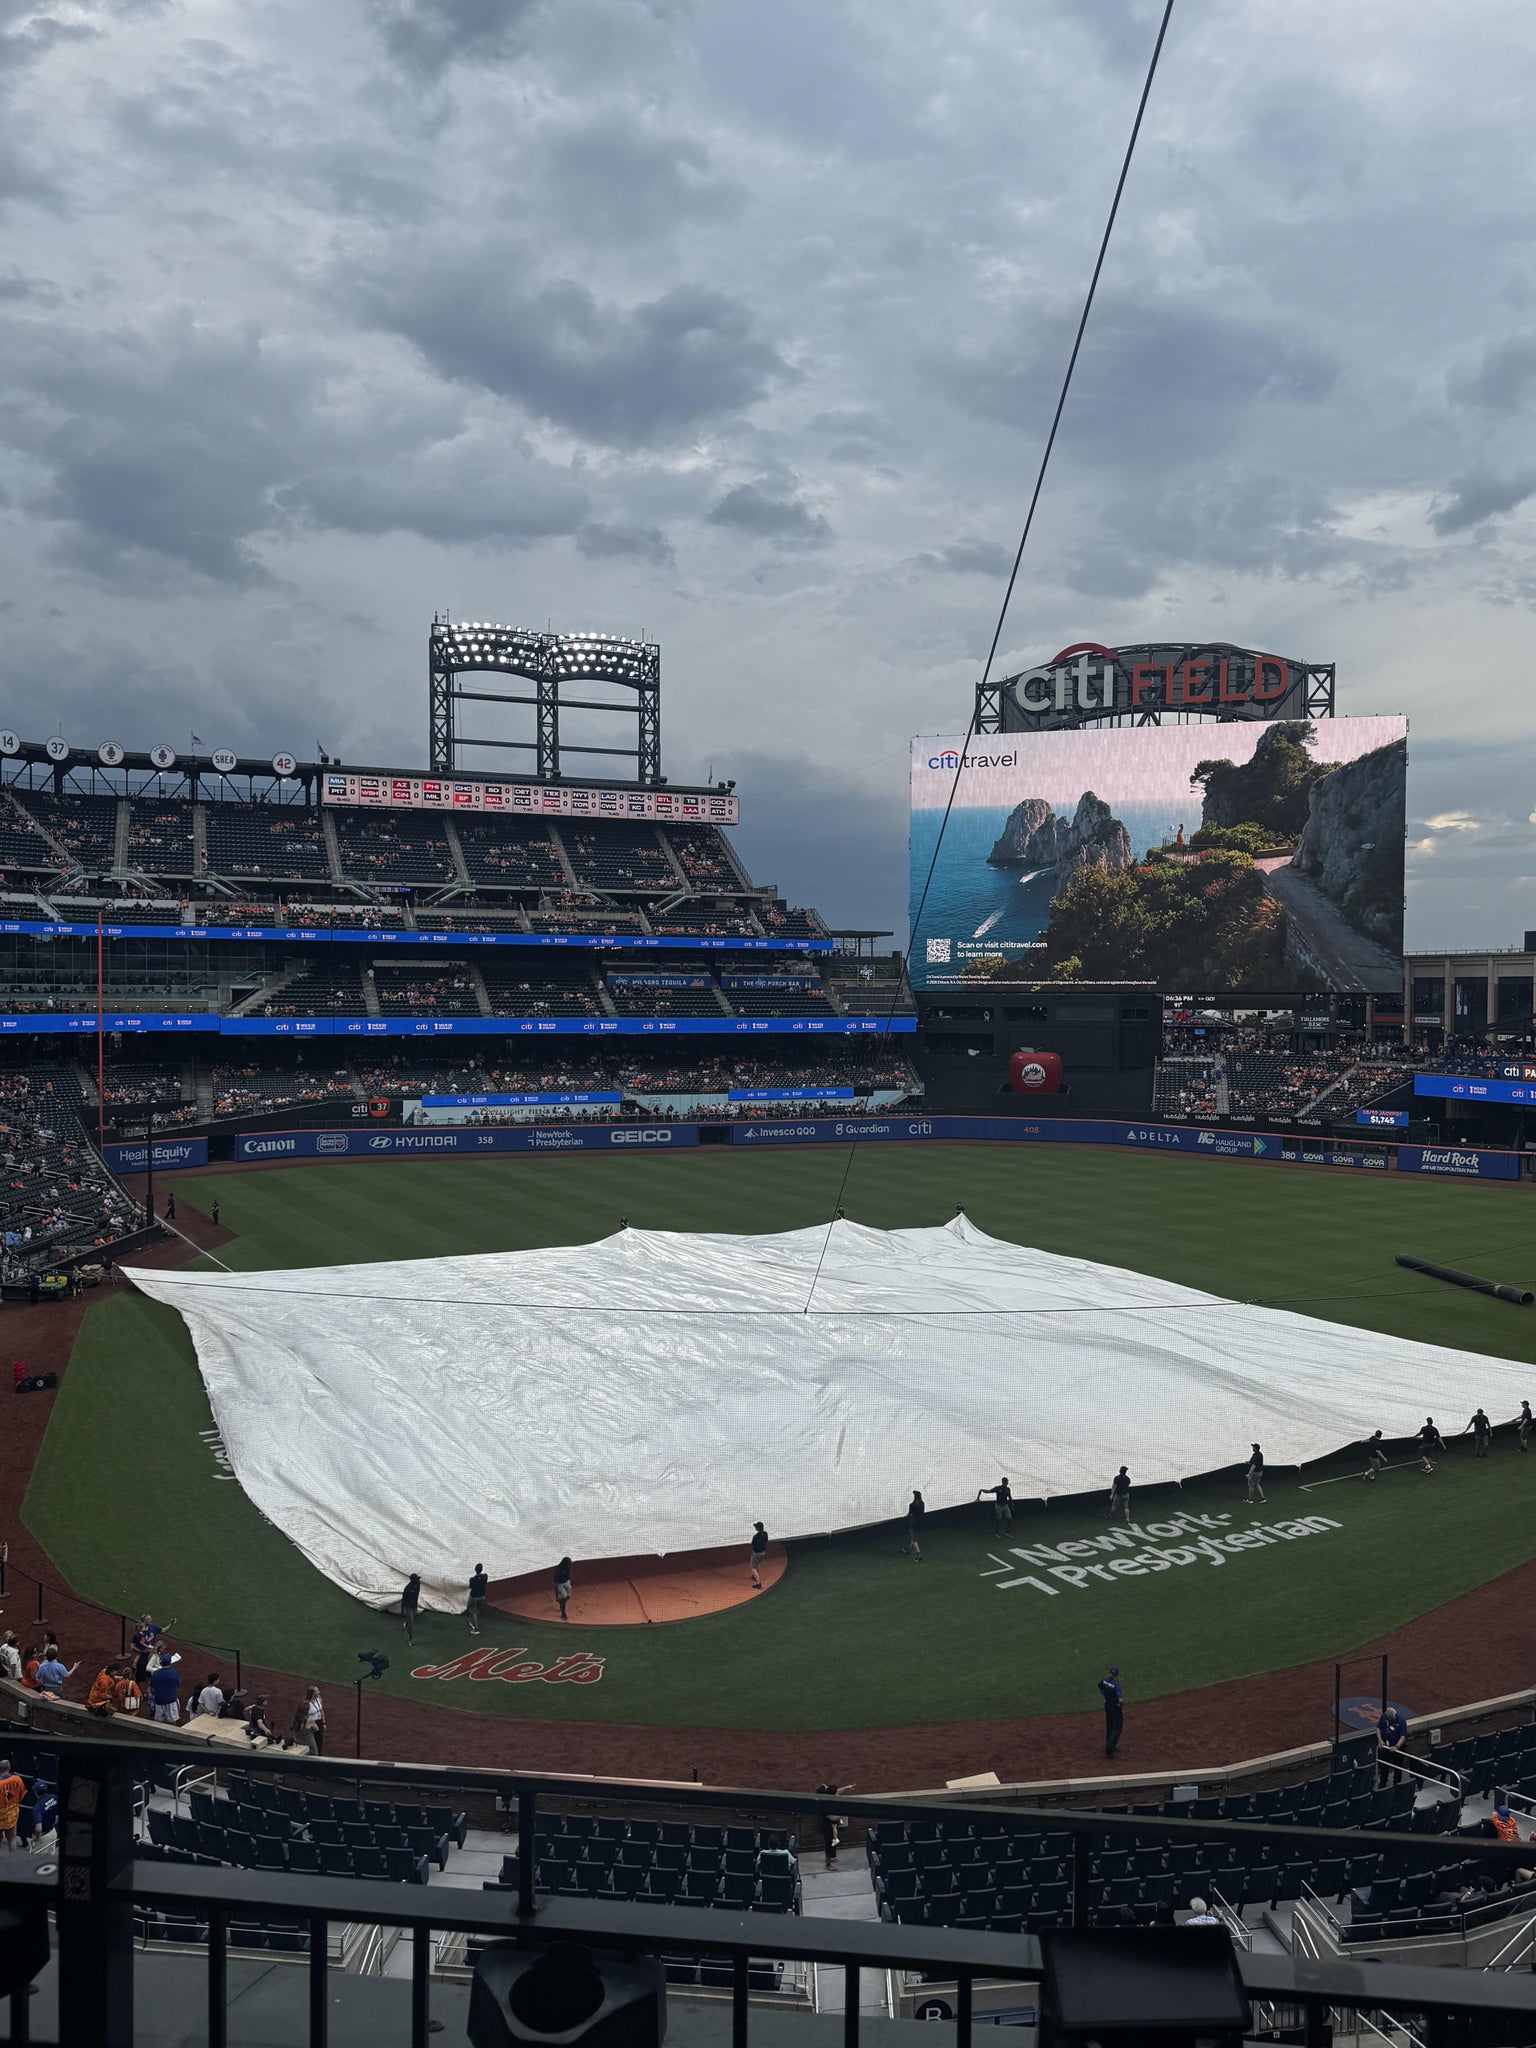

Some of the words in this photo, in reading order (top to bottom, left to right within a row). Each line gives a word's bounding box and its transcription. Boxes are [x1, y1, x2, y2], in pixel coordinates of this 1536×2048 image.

[1016, 654, 1114, 711] citi
[1132, 656, 1289, 706] FIELD
[3, 736, 13, 748] 14
[51, 742, 64, 755] 37
[215, 755, 234, 765] SHEA
[277, 758, 291, 769] 42
[928, 754, 958, 770] citi
[963, 750, 1017, 768] travel
[984, 941, 1000, 949] visit
[1000, 941, 1048, 949] cititravel.com
[276, 1022, 289, 1031] citi
[348, 1022, 361, 1030] citi
[416, 1022, 428, 1030] citi
[1504, 1064, 1520, 1077] citi
[1453, 1085, 1464, 1093] citi
[1512, 1090, 1524, 1098] citi
[351, 1104, 368, 1113] citi
[377, 1102, 387, 1111] 37
[1268, 1116, 1292, 1124] HubSpot
[1297, 1118, 1322, 1126] HubSpot
[1370, 1115, 1395, 1124] $1,745
[760, 1127, 796, 1137] Invesco
[796, 1126, 816, 1136] QQQ
[845, 1124, 890, 1134] Guardian
[908, 1121, 932, 1135] citi
[1023, 1126, 1039, 1134] 408
[536, 1131, 573, 1139] NewYork-
[610, 1129, 672, 1143] GEICO
[1139, 1131, 1180, 1143] DELTA
[395, 1136, 457, 1147] HYUNDAI
[477, 1136, 494, 1144] 358
[535, 1137, 583, 1147] Presbyterian
[1215, 1139, 1252, 1148] HAUGLAND
[244, 1139, 295, 1154] Canon
[1215, 1145, 1238, 1154] GROUP
[1280, 1151, 1296, 1160] 380
[1302, 1152, 1324, 1161] GOYA
[1332, 1155, 1354, 1164] GOYA
[1421, 1150, 1451, 1165] Hard
[1451, 1152, 1479, 1168] Rock
[1362, 1158, 1385, 1166] GOYA
[1429, 1165, 1467, 1173] METROPOLITAN
[1009, 1511, 1233, 1566] NewYork-
[1047, 1514, 1343, 1588] Presbyterian
[410, 1647, 607, 1684] Mets
[1367, 1748, 1373, 1756] A
[1342, 1754, 1348, 1763] B
